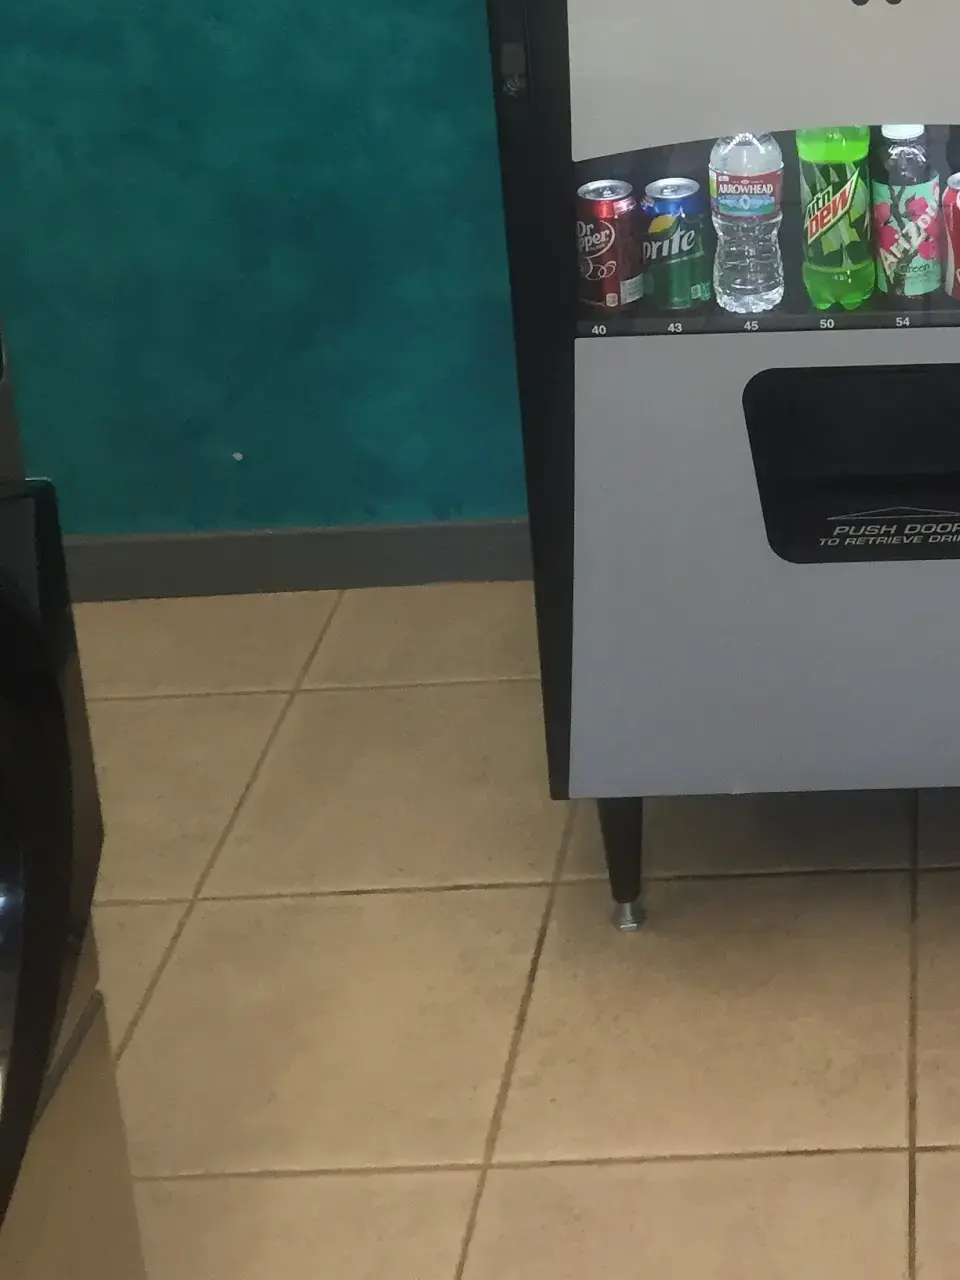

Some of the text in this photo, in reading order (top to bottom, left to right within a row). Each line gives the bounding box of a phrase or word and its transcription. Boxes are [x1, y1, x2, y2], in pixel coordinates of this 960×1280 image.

[718, 183, 774, 194] ARROWHEAD
[577, 221, 594, 237] Dr
[579, 229, 610, 253] pper
[643, 224, 696, 264] prite
[667, 322, 683, 332] 43
[744, 320, 759, 331] 45
[820, 319, 835, 329] 50
[896, 317, 910, 327] 54
[592, 325, 607, 335] 40
[833, 524, 897, 536] PUSH
[818, 538, 840, 546] TO
[844, 535, 923, 545] RETRIEVE
